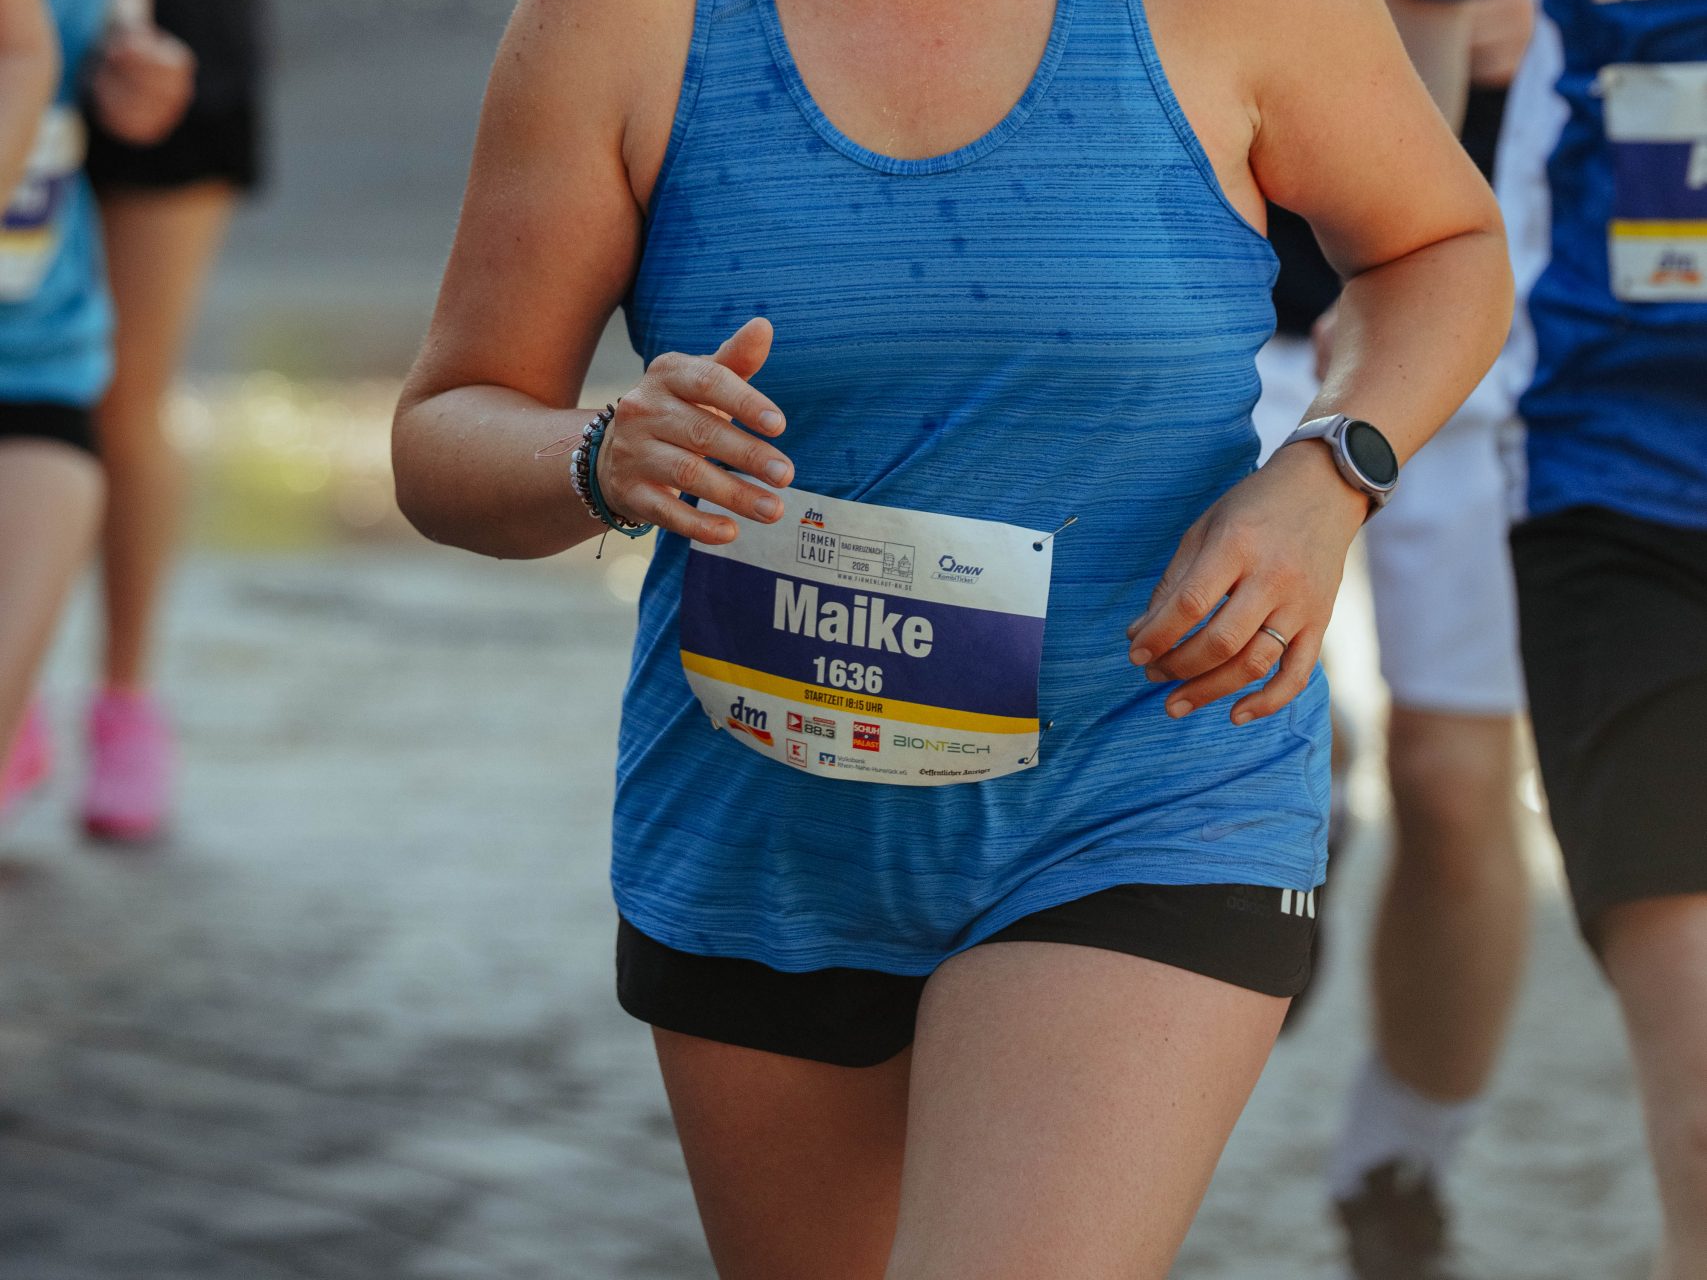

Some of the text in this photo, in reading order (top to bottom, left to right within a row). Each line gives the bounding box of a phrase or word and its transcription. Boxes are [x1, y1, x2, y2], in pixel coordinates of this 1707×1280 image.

[804, 508, 823, 522] dm
[802, 531, 836, 548] FIRMEN
[841, 542, 883, 555] BAD KREUZNACH
[801, 544, 835, 564] LAUF
[773, 578, 934, 659] Maike
[813, 656, 883, 694] 1636
[804, 689, 883, 713] STARTZEIT 18:15 UHR
[730, 696, 767, 730] dm
[804, 723, 835, 739] 88.3
[853, 723, 880, 735] SCHUH
[853, 738, 880, 749] PALAST
[893, 734, 991, 755] BIONTECH
